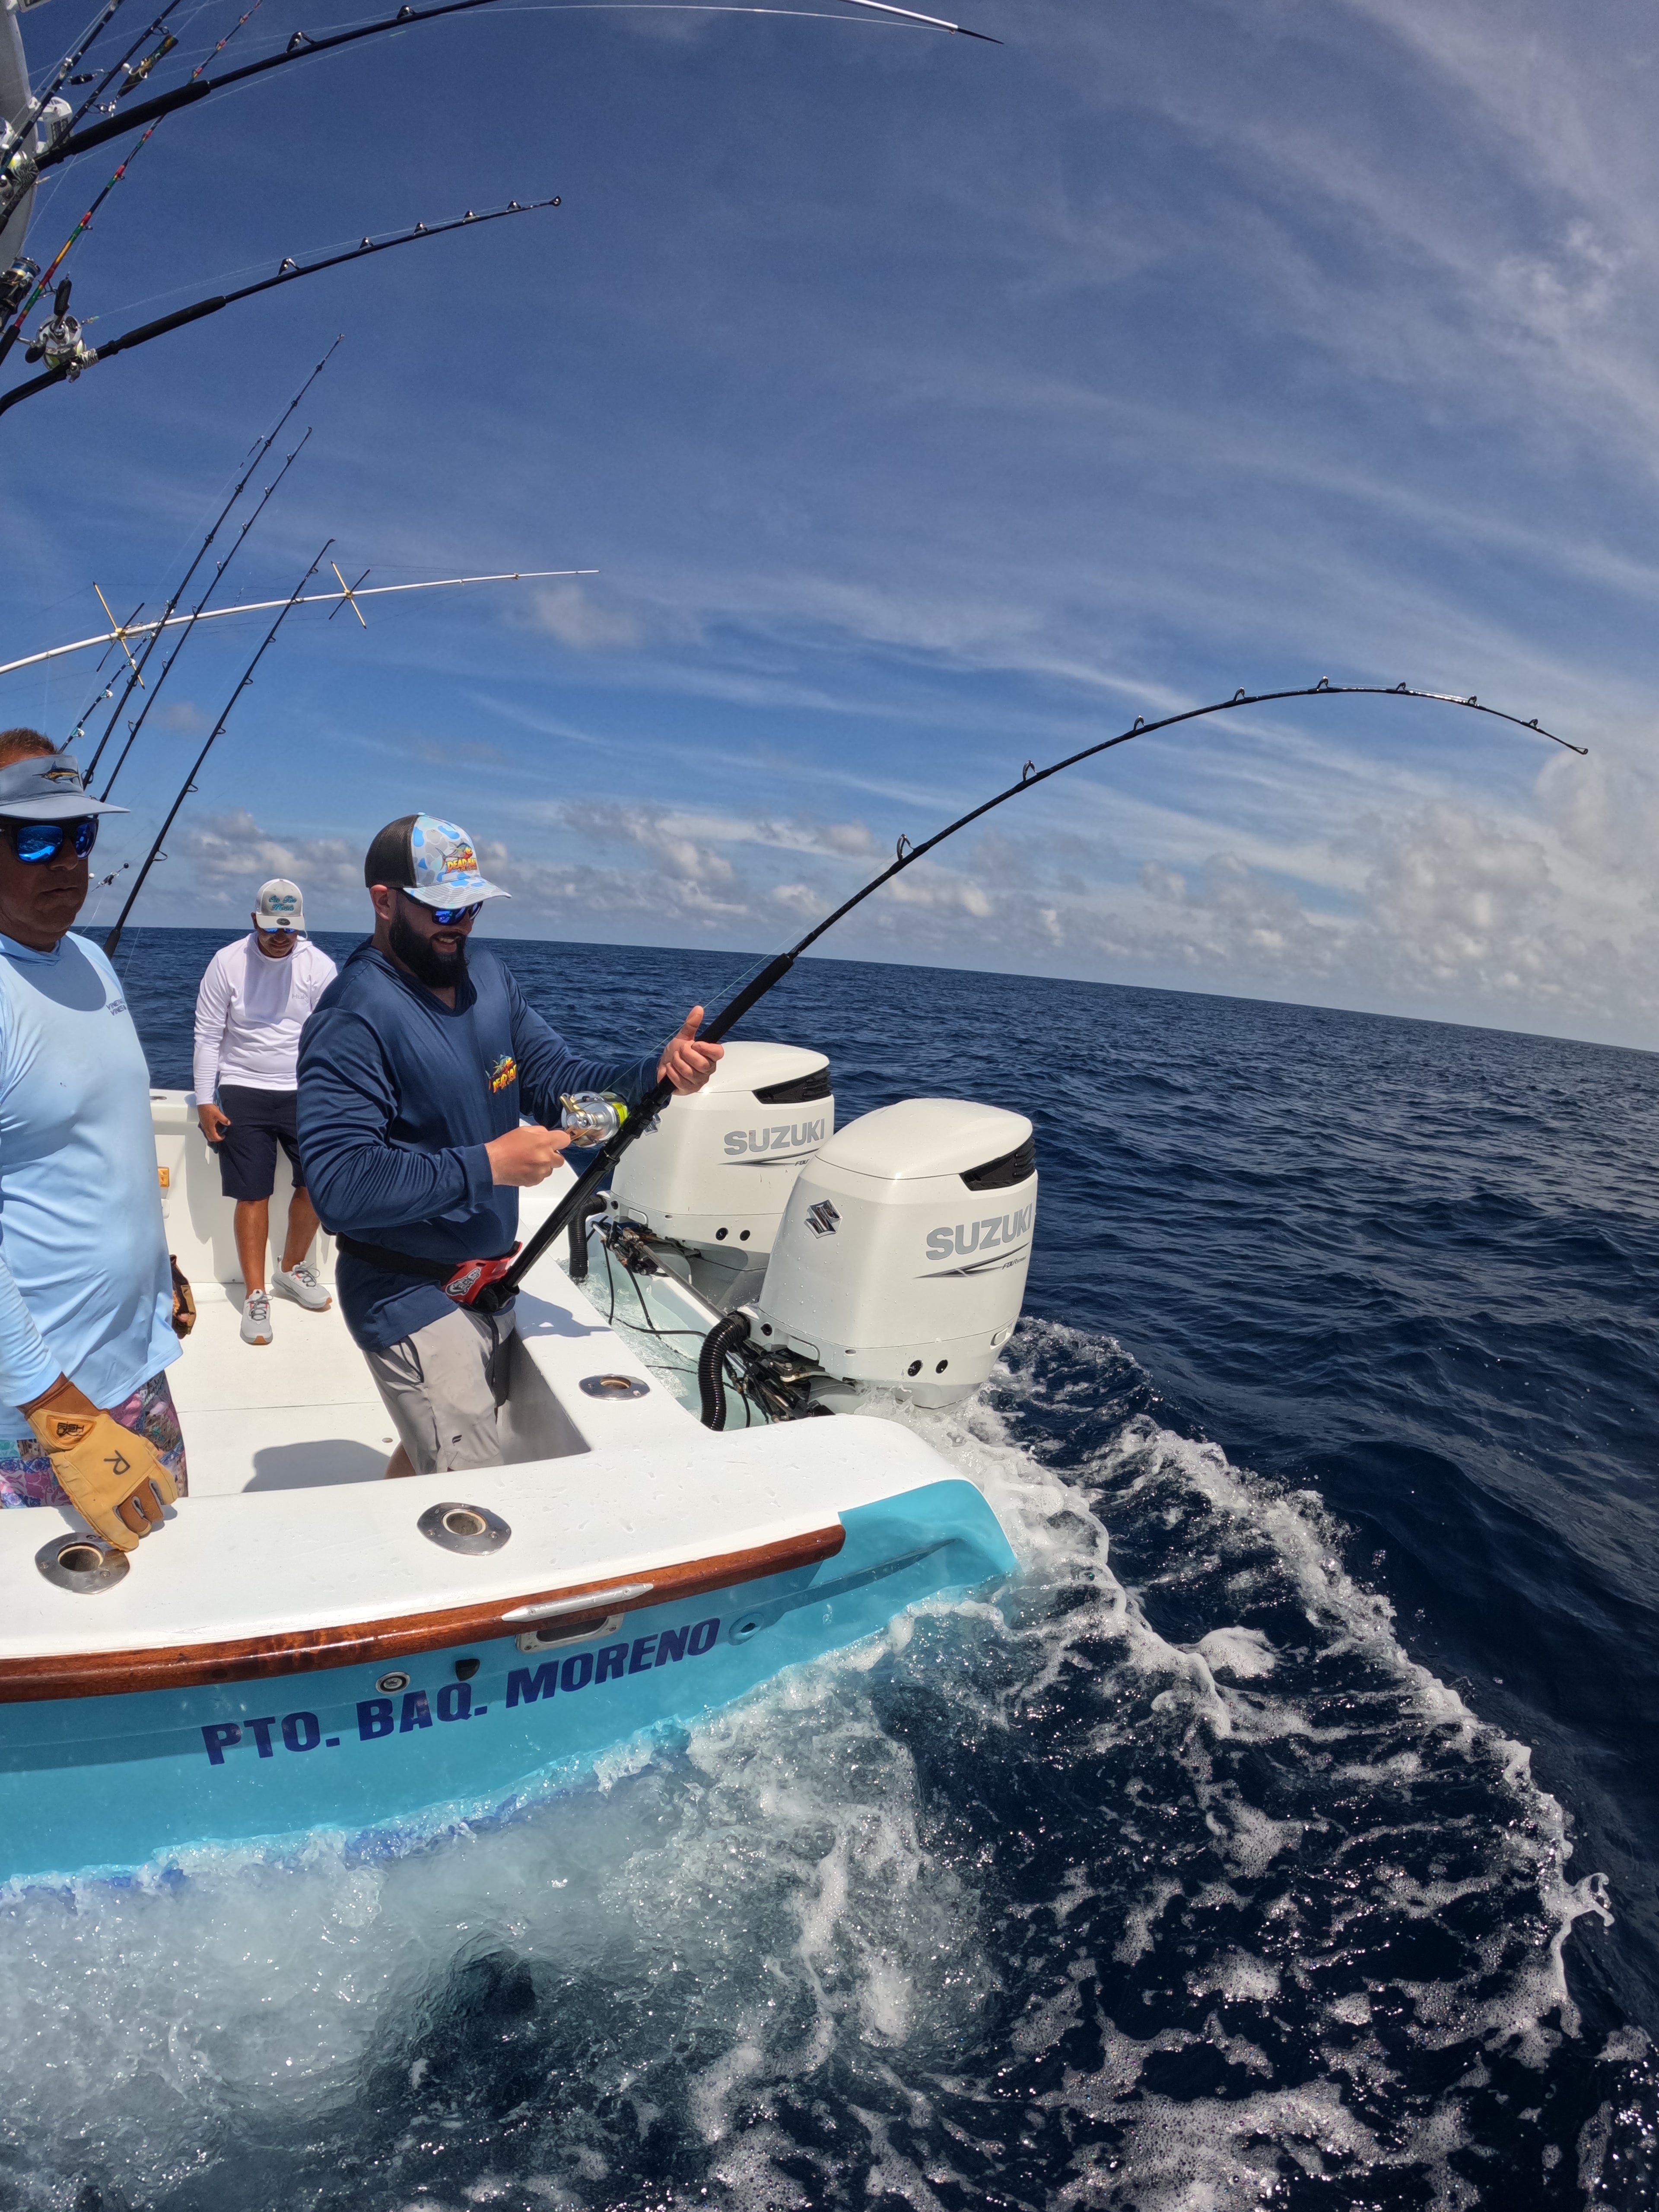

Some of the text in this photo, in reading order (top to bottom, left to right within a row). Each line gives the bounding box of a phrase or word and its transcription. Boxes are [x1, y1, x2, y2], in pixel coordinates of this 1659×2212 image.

[445, 858, 467, 874] DEAD
[269, 894, 297, 903] On The
[724, 1118, 825, 1155] SUZUKI
[926, 1202, 1033, 1260] SUZUKI
[1002, 1259, 1018, 1270] FOUR
[103, 1449, 130, 1475] R
[201, 1618, 721, 1765] PTO. BAQ. MORENO
